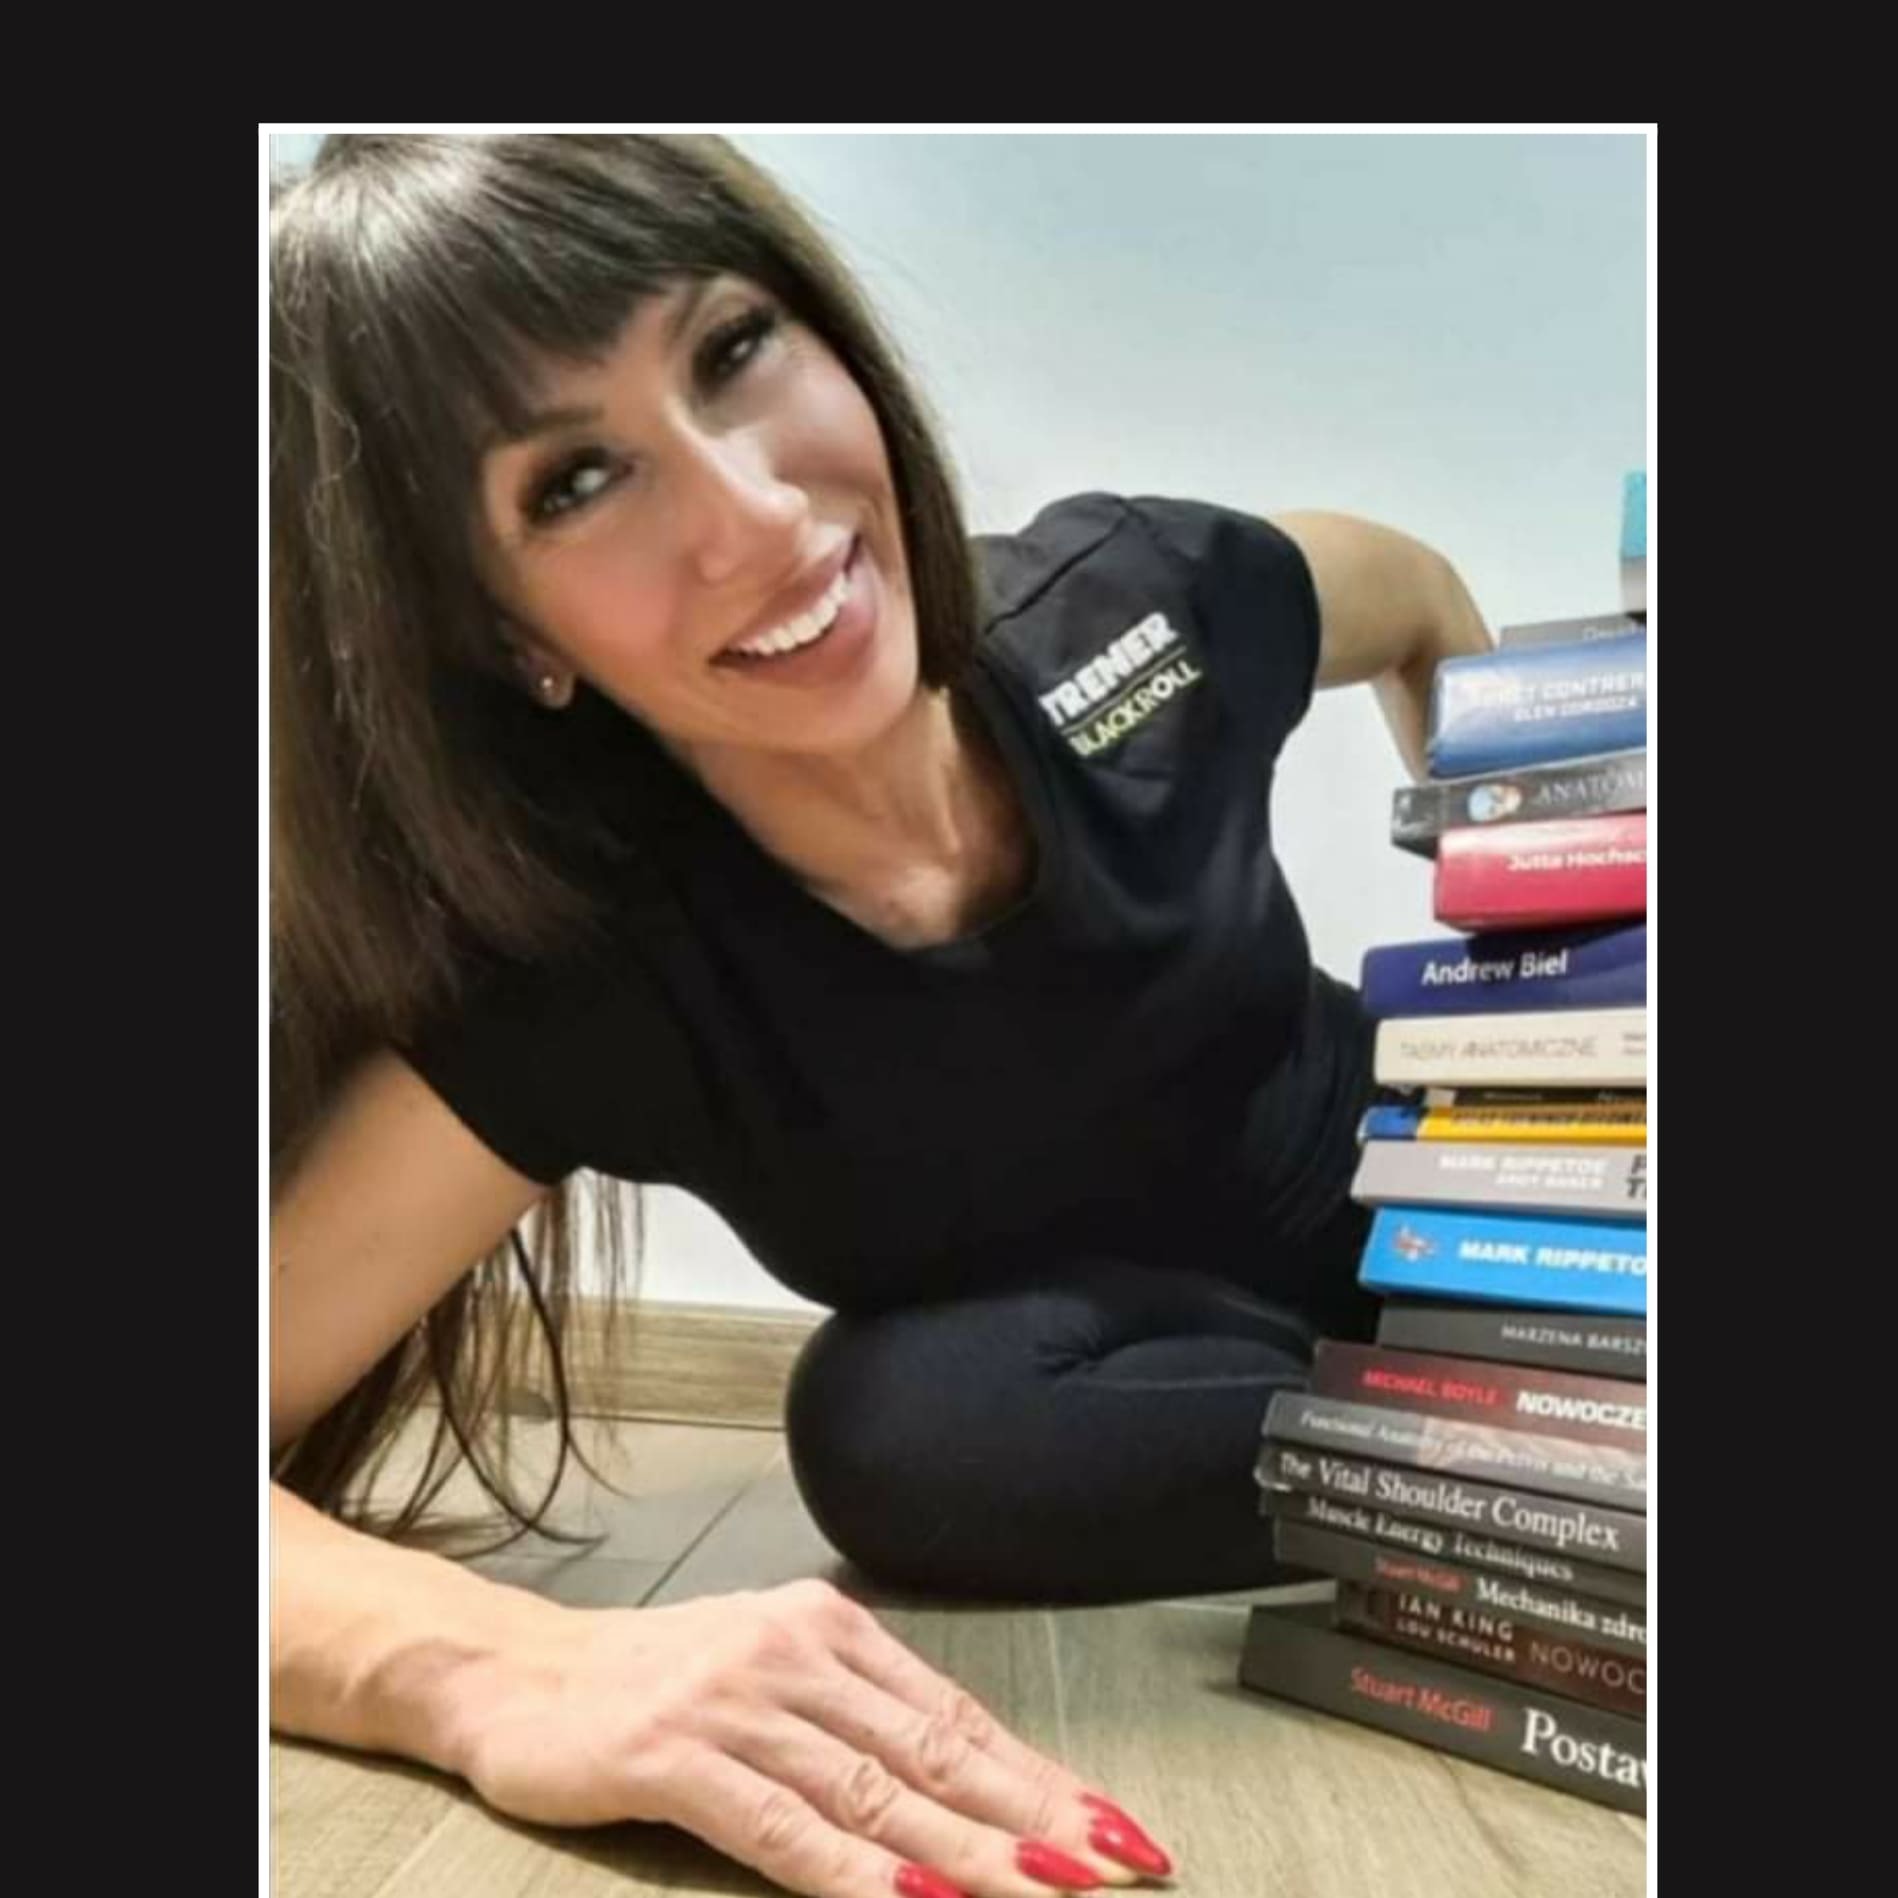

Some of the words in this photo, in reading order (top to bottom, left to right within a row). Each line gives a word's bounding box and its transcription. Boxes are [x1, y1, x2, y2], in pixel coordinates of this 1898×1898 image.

[1037, 611, 1179, 726] TRENER
[1068, 660, 1203, 758] BLACKROLL
[1506, 851, 1562, 872] Jutta
[1421, 956, 1514, 986] Andrew
[1519, 948, 1569, 979] Biel
[1438, 1152, 1495, 1170] MARK
[1458, 1238, 1530, 1265] MARK
[1502, 1323, 1583, 1348] MARZENA
[1362, 1368, 1437, 1397] MICHAEL
[1441, 1381, 1500, 1405] BOYLE
[1515, 1389, 1646, 1432] NOWOCZE
[1279, 1452, 1312, 1480] The
[1319, 1456, 1370, 1494] Vital
[1375, 1468, 1487, 1520] Shoulder
[1491, 1497, 1621, 1552] Complex
[1308, 1497, 1371, 1532] Muscle
[1375, 1510, 1444, 1554] Energy
[1452, 1531, 1575, 1582] Techniques
[1399, 1593, 1442, 1622] IAN
[1452, 1608, 1515, 1642] KING
[1476, 1576, 1597, 1631] Mechanika
[1396, 1615, 1432, 1638] LOU
[1436, 1627, 1516, 1663] SCHULER
[1529, 1641, 1646, 1695] NOWOC
[1351, 1666, 1416, 1704] Stuart
[1414, 1687, 1494, 1731] McGill
